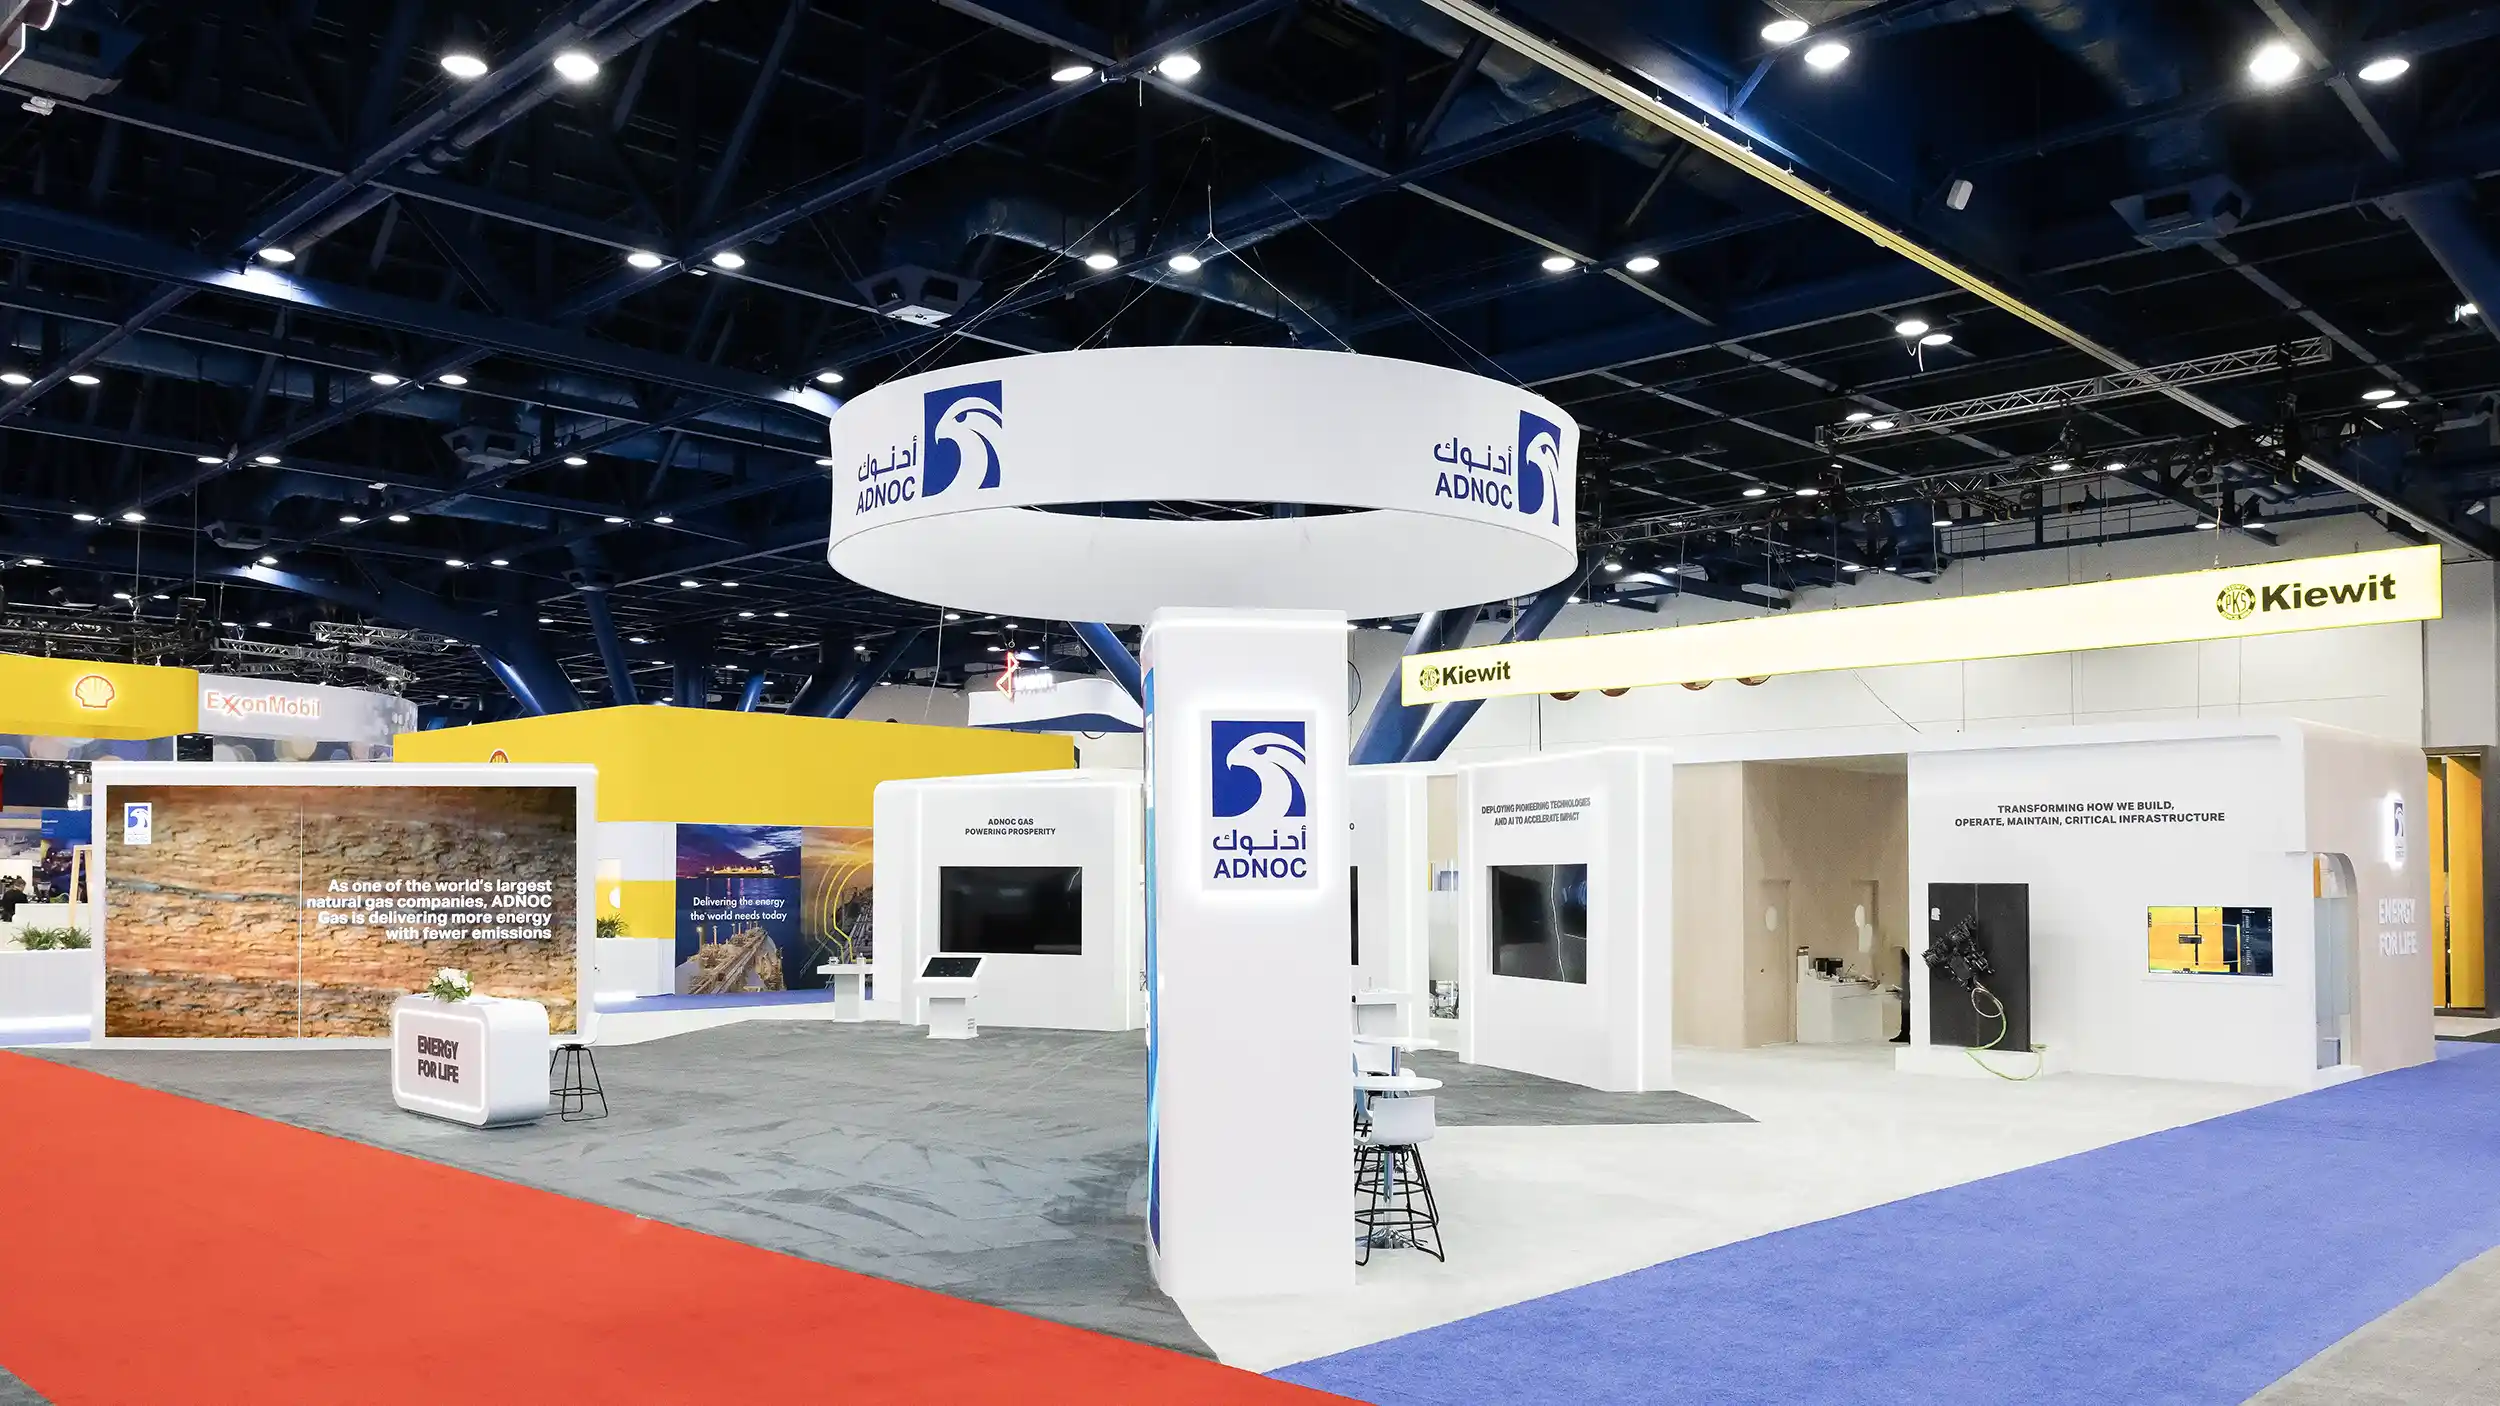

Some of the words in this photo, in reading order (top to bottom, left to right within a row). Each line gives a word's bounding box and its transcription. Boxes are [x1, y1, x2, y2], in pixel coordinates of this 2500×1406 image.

[858, 435, 917, 482] أدنوك
[1434, 437, 1512, 476] أدنوك
[856, 476, 915, 516] ADNOC
[1435, 472, 1513, 510] ADNOC
[2262, 573, 2396, 612] Kiewit
[1443, 661, 1511, 686] Kiewit
[207, 691, 320, 717] ExxonMobil
[1482, 804, 1514, 814] DEPLOYING
[1515, 801, 1549, 812] PIONEERING
[1550, 797, 1591, 809] TECHNOLOGIES
[1998, 803, 2084, 814] TRANSFORMING
[2087, 802, 2114, 812] HOW
[2117, 802, 2135, 811] WE
[2137, 801, 2175, 812] BUILD,
[1494, 817, 1507, 826] AND
[1508, 816, 1514, 825] AI
[1515, 816, 1523, 825] TO
[1524, 813, 1559, 824] ACCELERATE
[1560, 812, 1580, 821] IMPACT
[1955, 817, 2004, 827] OPERATE,
[2007, 815, 2062, 827] MAINTAIN,
[2065, 814, 2116, 825] CRITICAL
[2119, 812, 2225, 823] INFRASTRUCTURE
[1213, 825, 1307, 856] أدنوك
[1213, 857, 1307, 878] ADNOC
[328, 880, 349, 892] As
[352, 882, 382, 892] one
[385, 879, 402, 892] of
[406, 880, 432, 892] the
[435, 879, 493, 892] world's
[496, 880, 552, 895] largest
[307, 895, 361, 908] natural
[365, 898, 393, 911] gas
[397, 895, 487, 911] companies,
[491, 895, 552, 908] ADNOC
[693, 896, 737, 908] Delivering
[740, 896, 753, 905] the
[755, 899, 785, 908] energy
[2379, 899, 2416, 924] ENERGY
[318, 912, 349, 924] Gas
[351, 911, 364, 924] is
[368, 911, 448, 926] delivering
[452, 913, 491, 924] more
[496, 913, 552, 926] energy
[690, 911, 705, 920] the
[707, 911, 732, 920] world
[735, 910, 760, 920] needs
[762, 910, 787, 922] today
[386, 927, 419, 940] with
[423, 927, 468, 940] fewer
[471, 927, 552, 940] emissions
[2379, 931, 2397, 956] FOR
[2399, 930, 2417, 955] LIFE
[418, 1035, 459, 1060] ENERGY
[418, 1059, 437, 1079] FOR
[438, 1062, 459, 1084] LIFE
